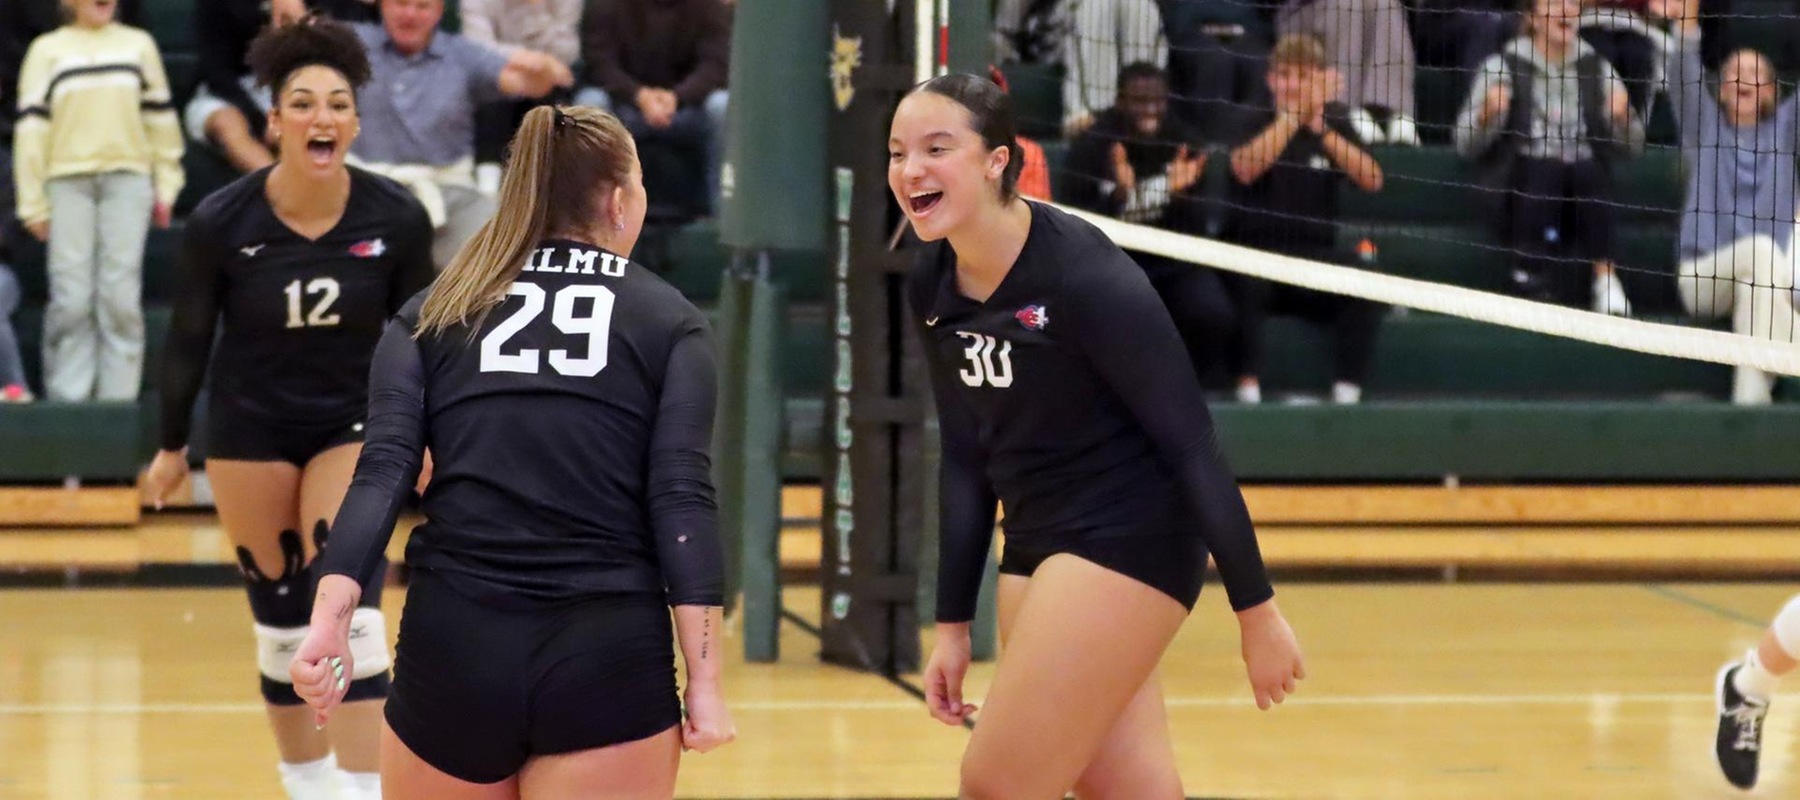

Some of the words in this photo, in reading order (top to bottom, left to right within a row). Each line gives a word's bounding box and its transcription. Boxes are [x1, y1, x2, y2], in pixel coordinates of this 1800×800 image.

[522, 247, 629, 277] ILMU
[284, 276, 341, 329] 12
[480, 281, 616, 378] 29
[956, 330, 1014, 388] 30
